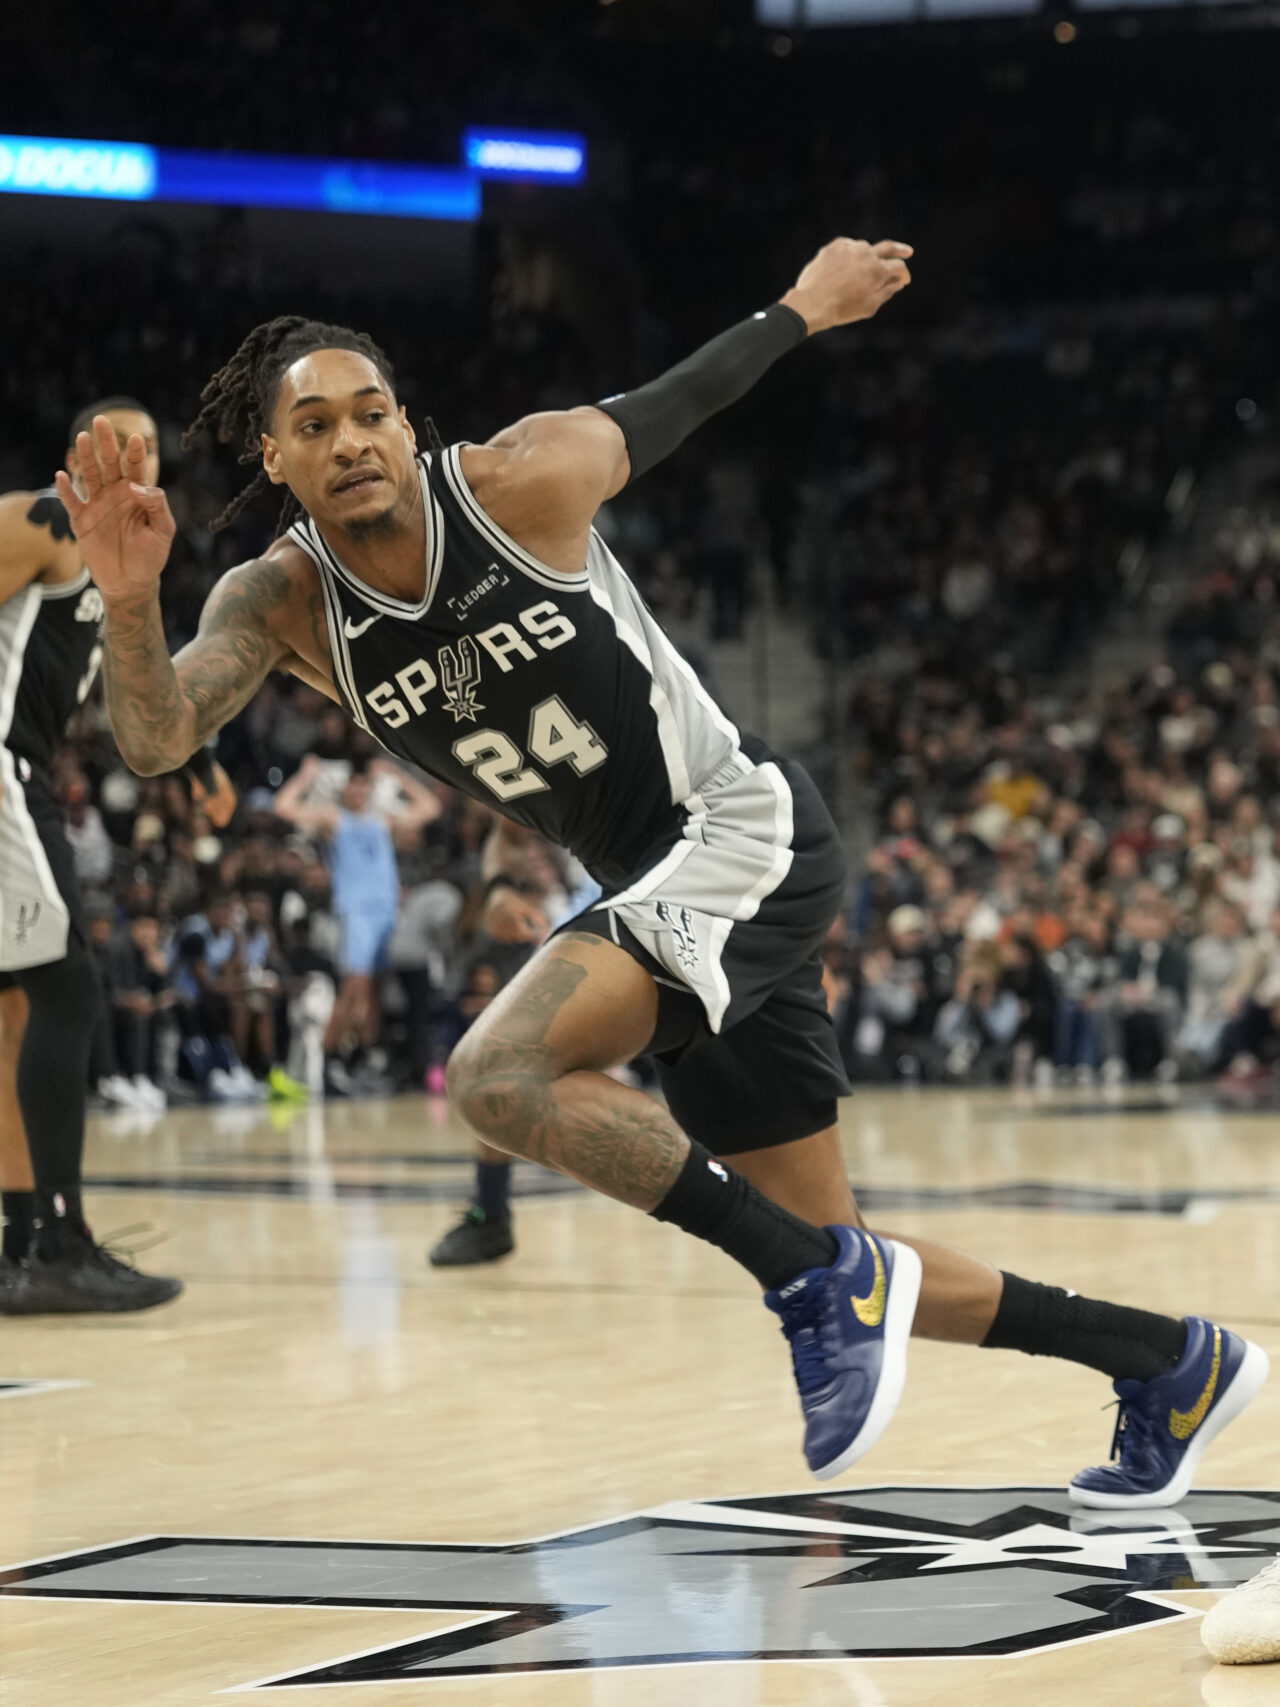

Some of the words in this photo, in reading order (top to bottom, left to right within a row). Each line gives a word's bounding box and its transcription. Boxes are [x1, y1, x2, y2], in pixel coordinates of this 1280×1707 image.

[457, 573, 499, 611] LEDGER
[365, 600, 577, 729] SPURS
[451, 693, 608, 803] 24
